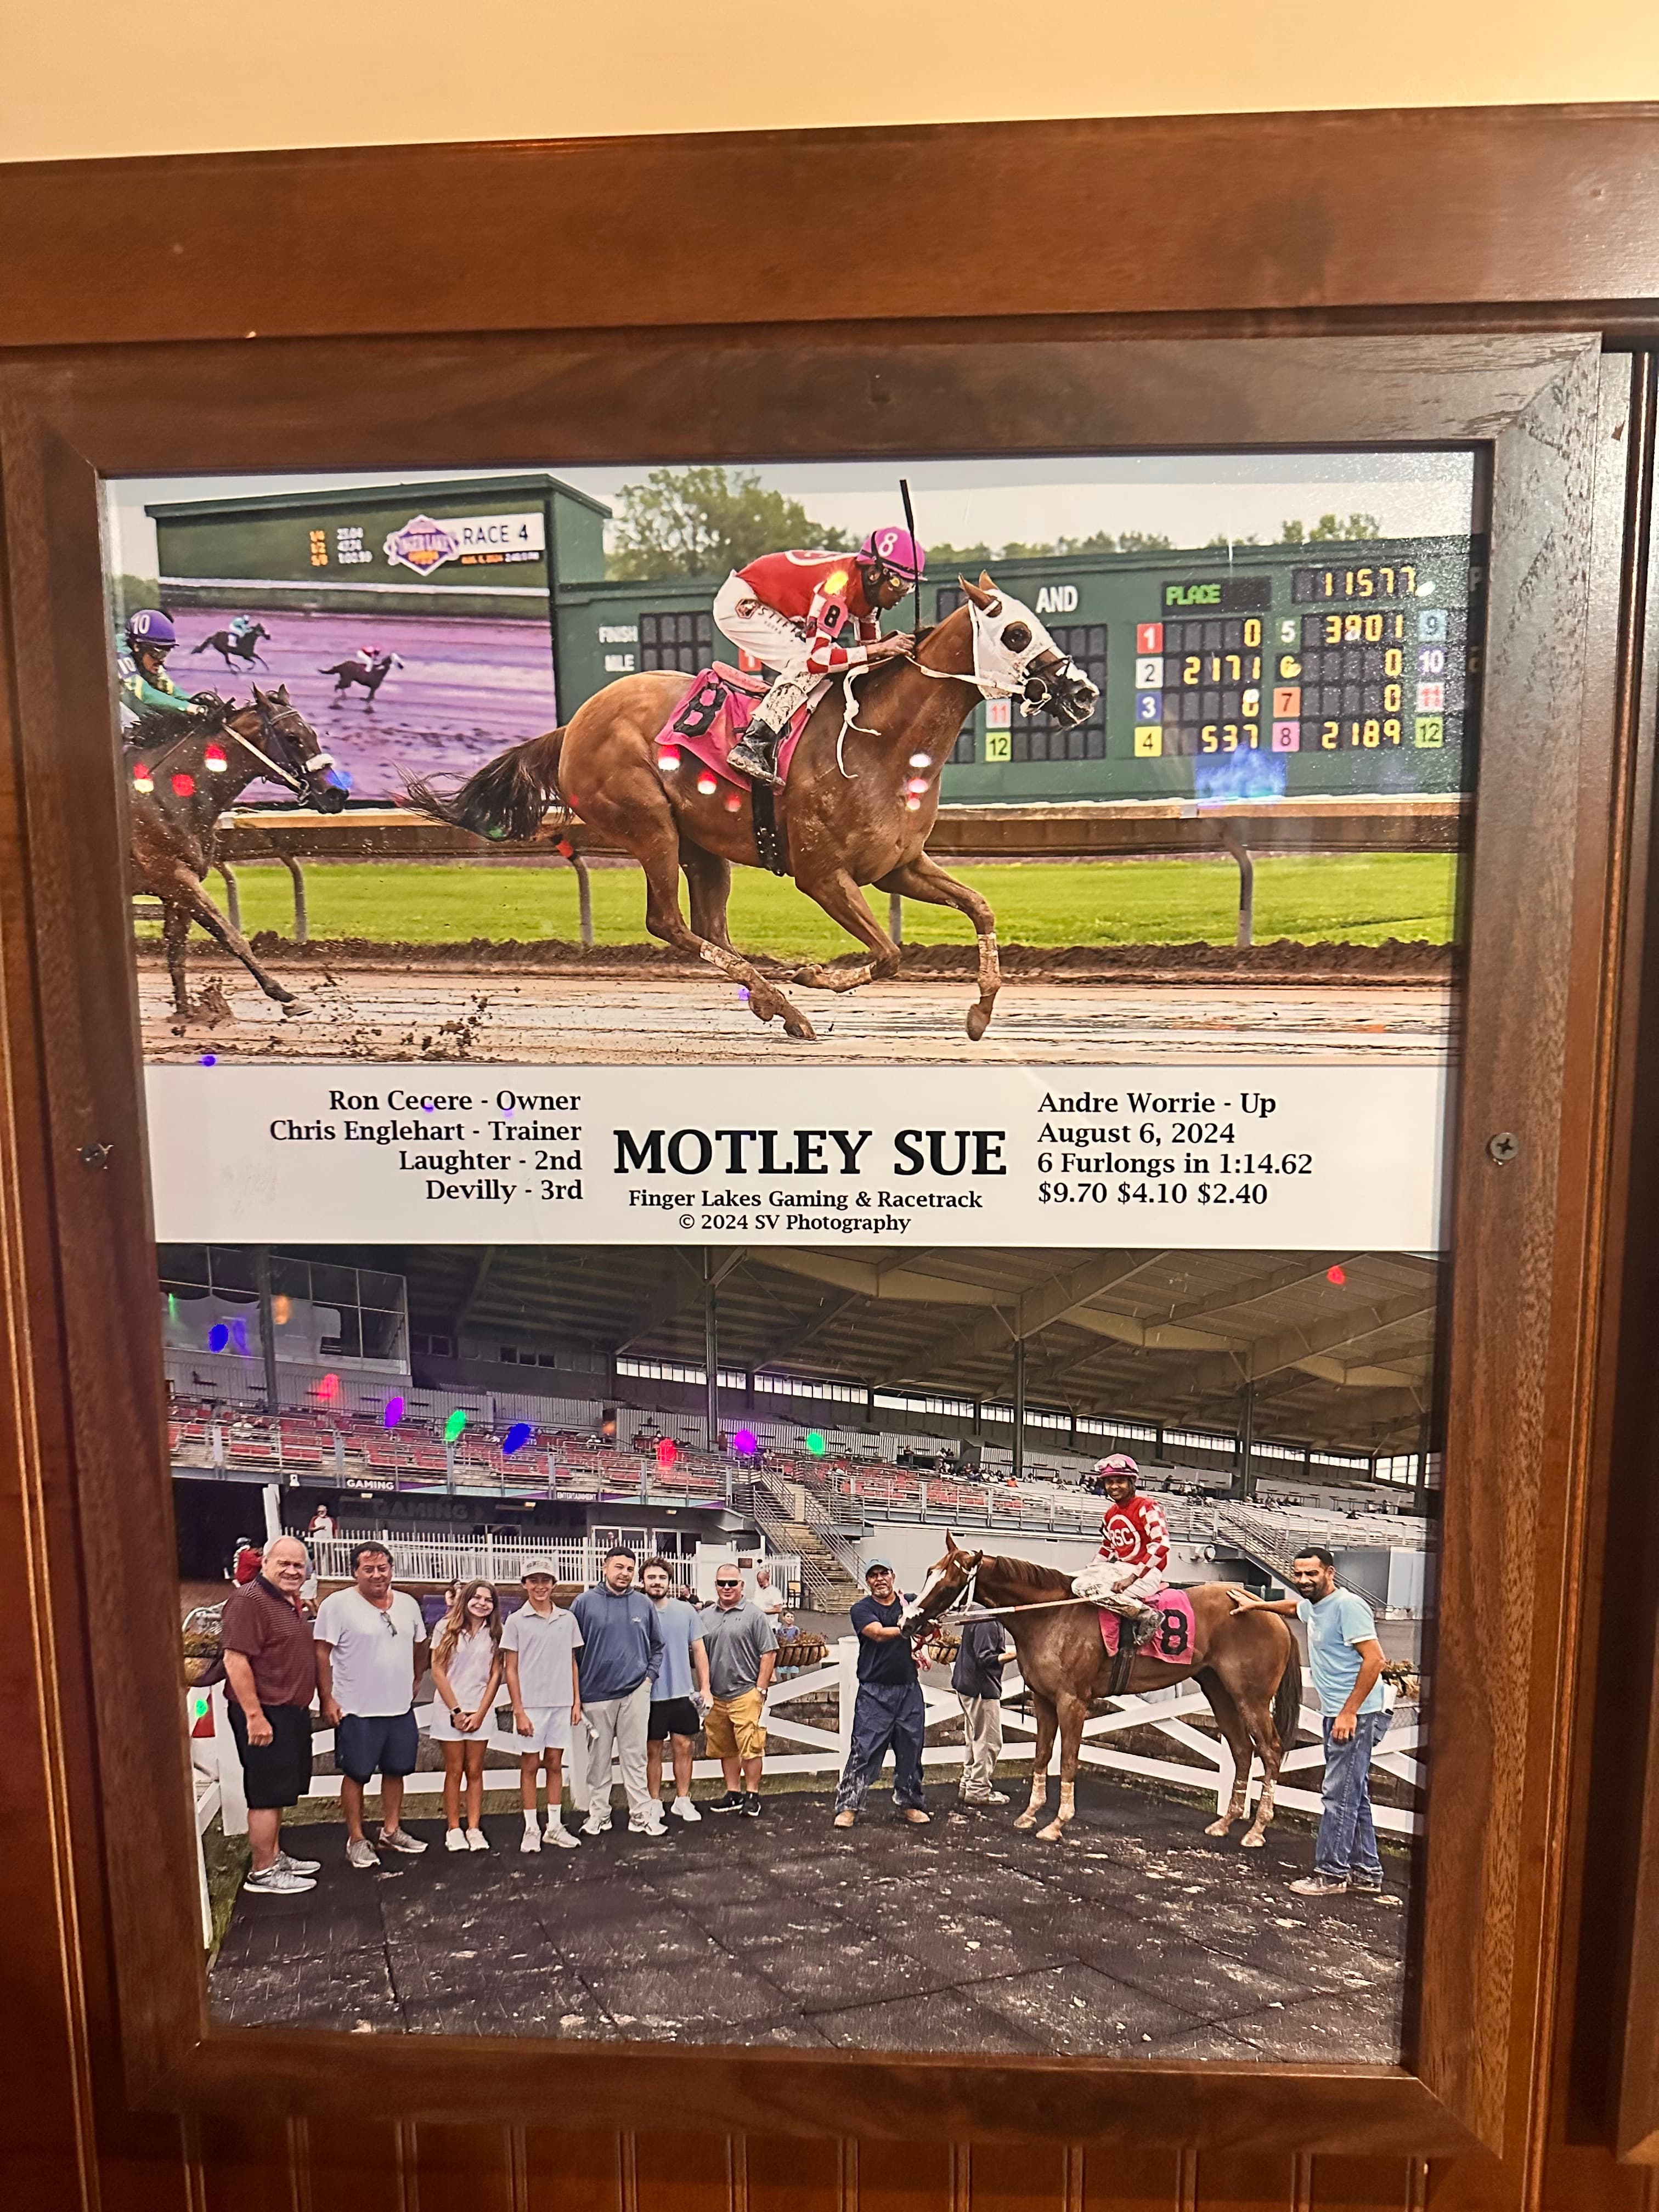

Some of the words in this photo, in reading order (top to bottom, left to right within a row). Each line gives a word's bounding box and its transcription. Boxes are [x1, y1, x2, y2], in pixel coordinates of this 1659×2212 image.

[464, 525, 509, 544] RACE
[518, 524, 528, 541] 4
[877, 533, 898, 556] 8
[1325, 566, 1415, 597] 11577
[1036, 586, 1078, 613] AND
[1166, 584, 1221, 605] PLACE
[131, 614, 150, 635] 10
[825, 605, 840, 628] 8
[1426, 616, 1436, 635] 9
[1144, 627, 1155, 650] 1
[1244, 619, 1261, 647] 0
[1281, 620, 1295, 643] 5
[117, 657, 136, 674] 10
[1144, 664, 1155, 682] 2
[1183, 655, 1260, 684] 2171
[1385, 648, 1402, 676] 0
[1419, 650, 1444, 674] 10
[1142, 696, 1156, 718] 3
[1281, 693, 1292, 712] 7
[1384, 684, 1401, 712] 0
[1421, 686, 1440, 707] 11
[673, 684, 728, 738] 8
[992, 704, 1007, 723] 11
[1142, 733, 1154, 751] 4
[1201, 724, 1258, 753] 537
[1281, 727, 1291, 746] 8
[1322, 719, 1401, 749] 2189
[1420, 723, 1440, 742] 12
[990, 738, 1008, 756] 12
[329, 1090, 379, 1110] Ron
[387, 1090, 472, 1110] Cecere
[496, 1090, 580, 1110] Owner
[1037, 1092, 1118, 1113] Andre
[1127, 1092, 1215, 1113] Worrie
[1240, 1093, 1276, 1118] Up
[270, 1119, 335, 1141] Chris
[344, 1120, 465, 1145] Englehart
[488, 1120, 582, 1141] Trainer
[1037, 1122, 1131, 1147] August
[1139, 1122, 1161, 1147] 6,
[1171, 1122, 1235, 1144] 2024
[399, 1150, 511, 1175] Laughter
[535, 1150, 583, 1170] 2nd
[613, 1129, 873, 1175] MOTLEY
[894, 1129, 1007, 1176] SUE
[1038, 1152, 1053, 1173] 6
[1061, 1152, 1175, 1178] Furlongs
[1184, 1152, 1210, 1173] in
[1220, 1154, 1312, 1175] 1:14.62
[426, 1180, 517, 1204] Devilly
[541, 1179, 583, 1200] 3rd
[629, 1189, 695, 1210] Finger
[702, 1189, 761, 1206] Lakes
[769, 1190, 849, 1210] Gaming
[855, 1191, 871, 1207] &
[878, 1190, 983, 1207] Racetrack
[1039, 1181, 1107, 1204] $9.70
[1118, 1181, 1187, 1205] $4.10
[1198, 1182, 1267, 1205] $2.40
[679, 1214, 695, 1229] ©
[702, 1215, 748, 1229] 2024
[755, 1215, 780, 1229] SV
[786, 1214, 911, 1234] Photography
[346, 1479, 394, 1491] GAMING
[1160, 1609, 1188, 1655] 8
